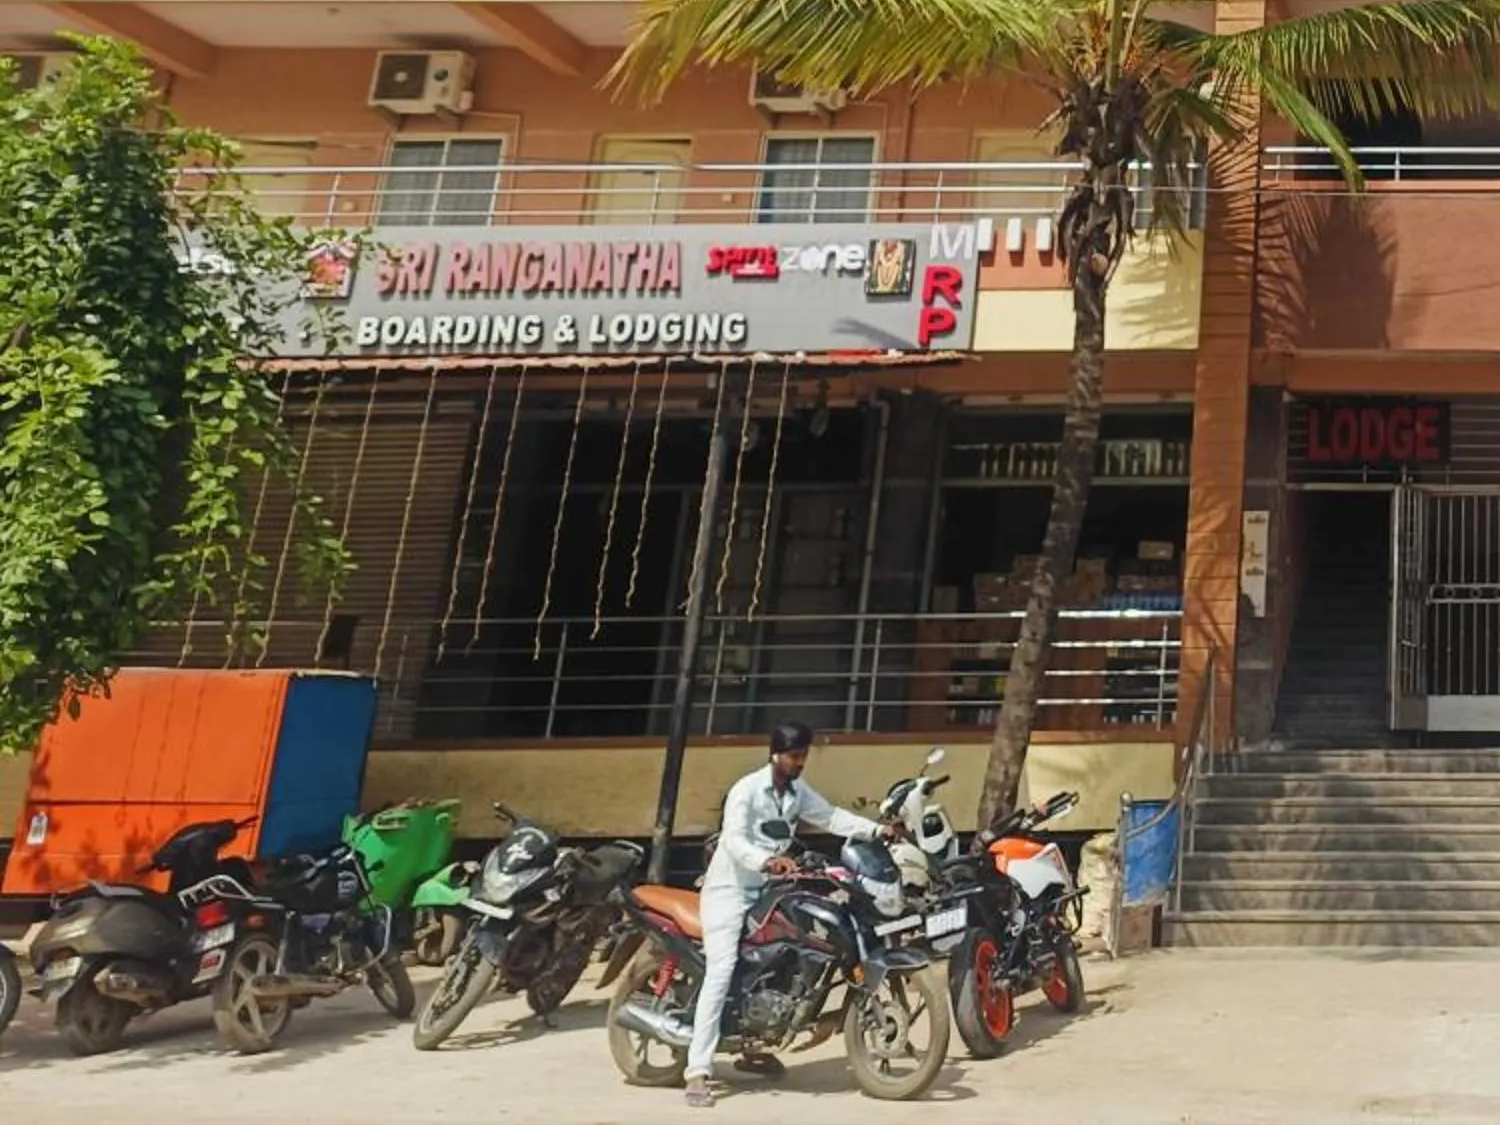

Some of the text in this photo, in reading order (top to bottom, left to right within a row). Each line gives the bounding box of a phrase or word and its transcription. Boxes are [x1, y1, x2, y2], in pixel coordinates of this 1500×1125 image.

[376, 241, 682, 293] SRI RANGANATHA
[357, 312, 746, 345] BOARDING & LODGING
[1308, 406, 1440, 463] LODGE
